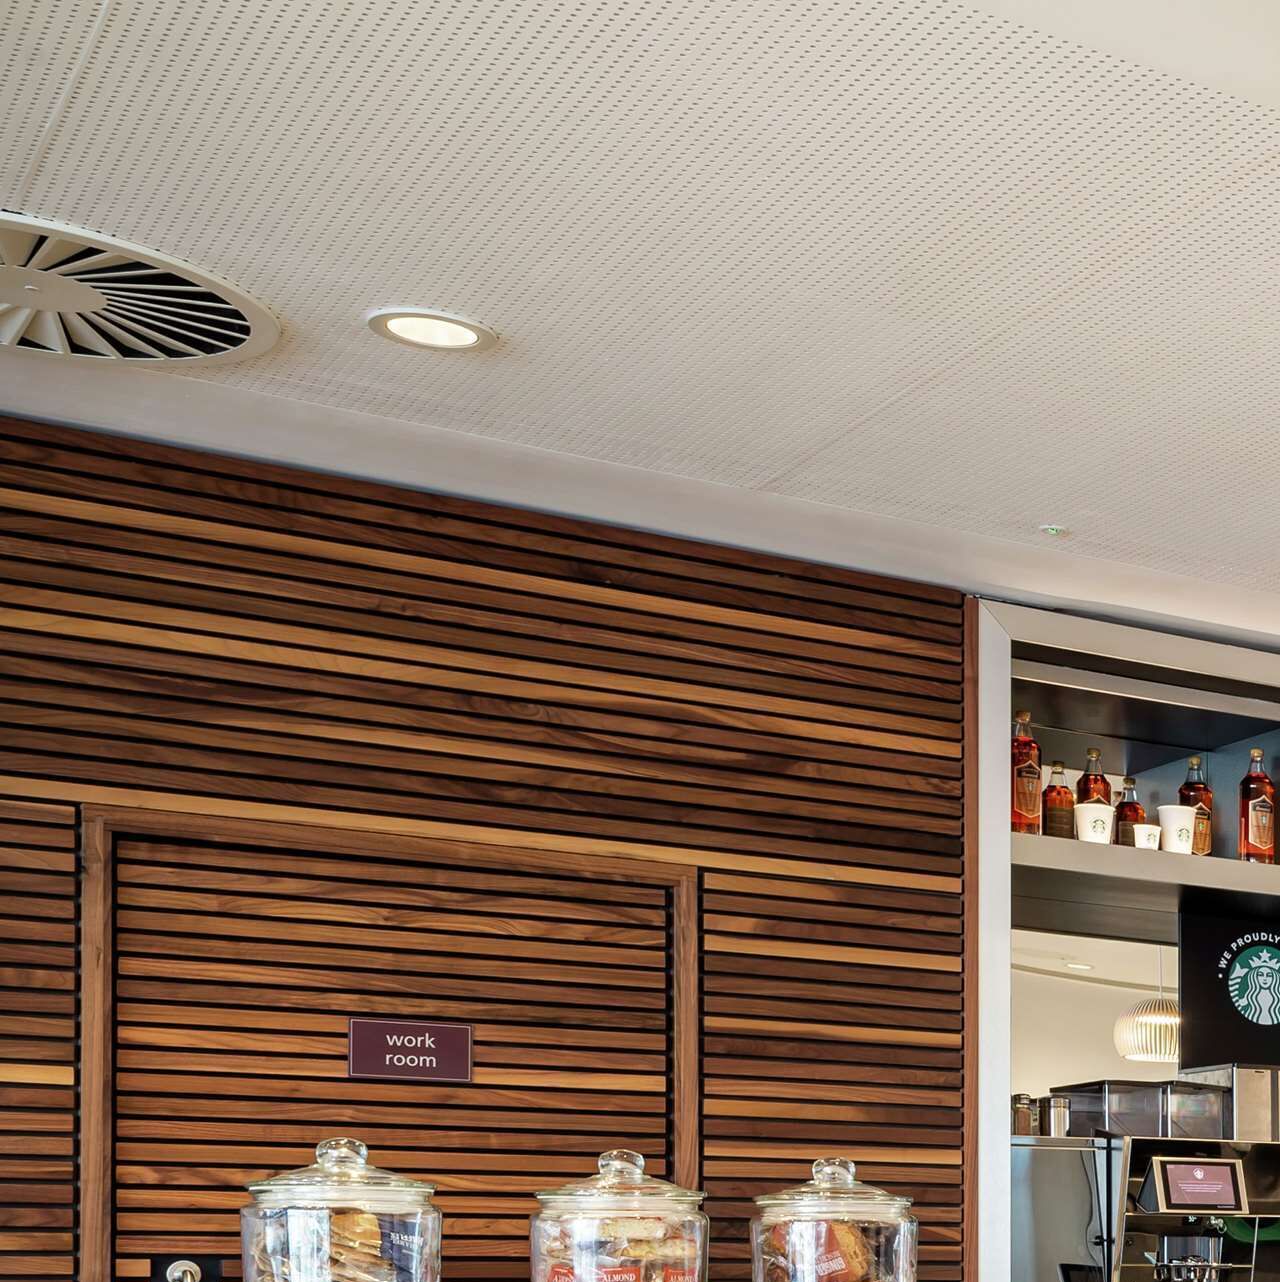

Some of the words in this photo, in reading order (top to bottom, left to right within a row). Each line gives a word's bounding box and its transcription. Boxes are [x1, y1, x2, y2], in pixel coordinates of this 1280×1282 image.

[1218, 951, 1232, 968] WE
[1231, 932, 1280, 951] PROUDLY
[386, 1033, 436, 1049] work
[385, 1054, 437, 1068] room
[602, 1273, 636, 1282] ALMOND
